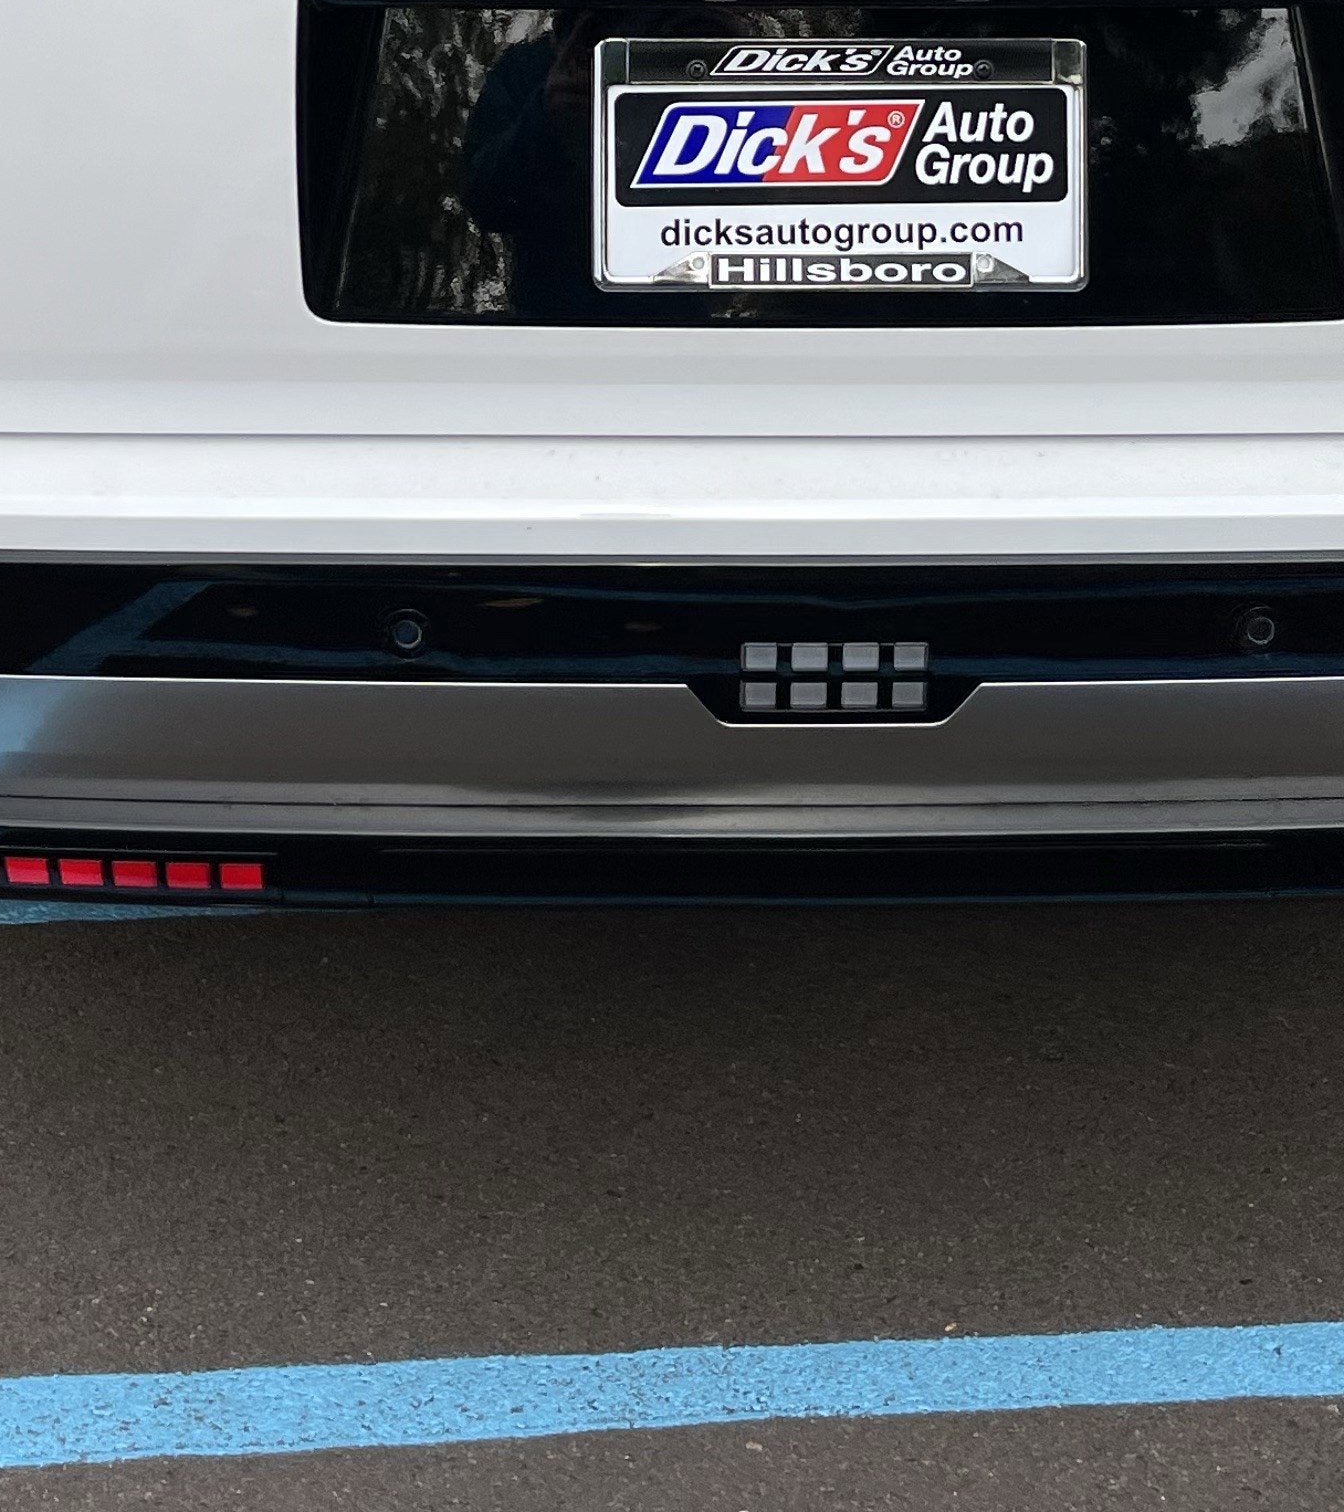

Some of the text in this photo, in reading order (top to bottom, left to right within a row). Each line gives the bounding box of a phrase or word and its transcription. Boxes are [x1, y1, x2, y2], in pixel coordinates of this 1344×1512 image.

[900, 45, 962, 63] Auto
[886, 60, 974, 80] Group
[922, 101, 1035, 144] Auto
[915, 144, 1055, 193] Group
[659, 218, 1025, 251] dicksautogroup.com
[716, 257, 967, 284] Hillsboro
